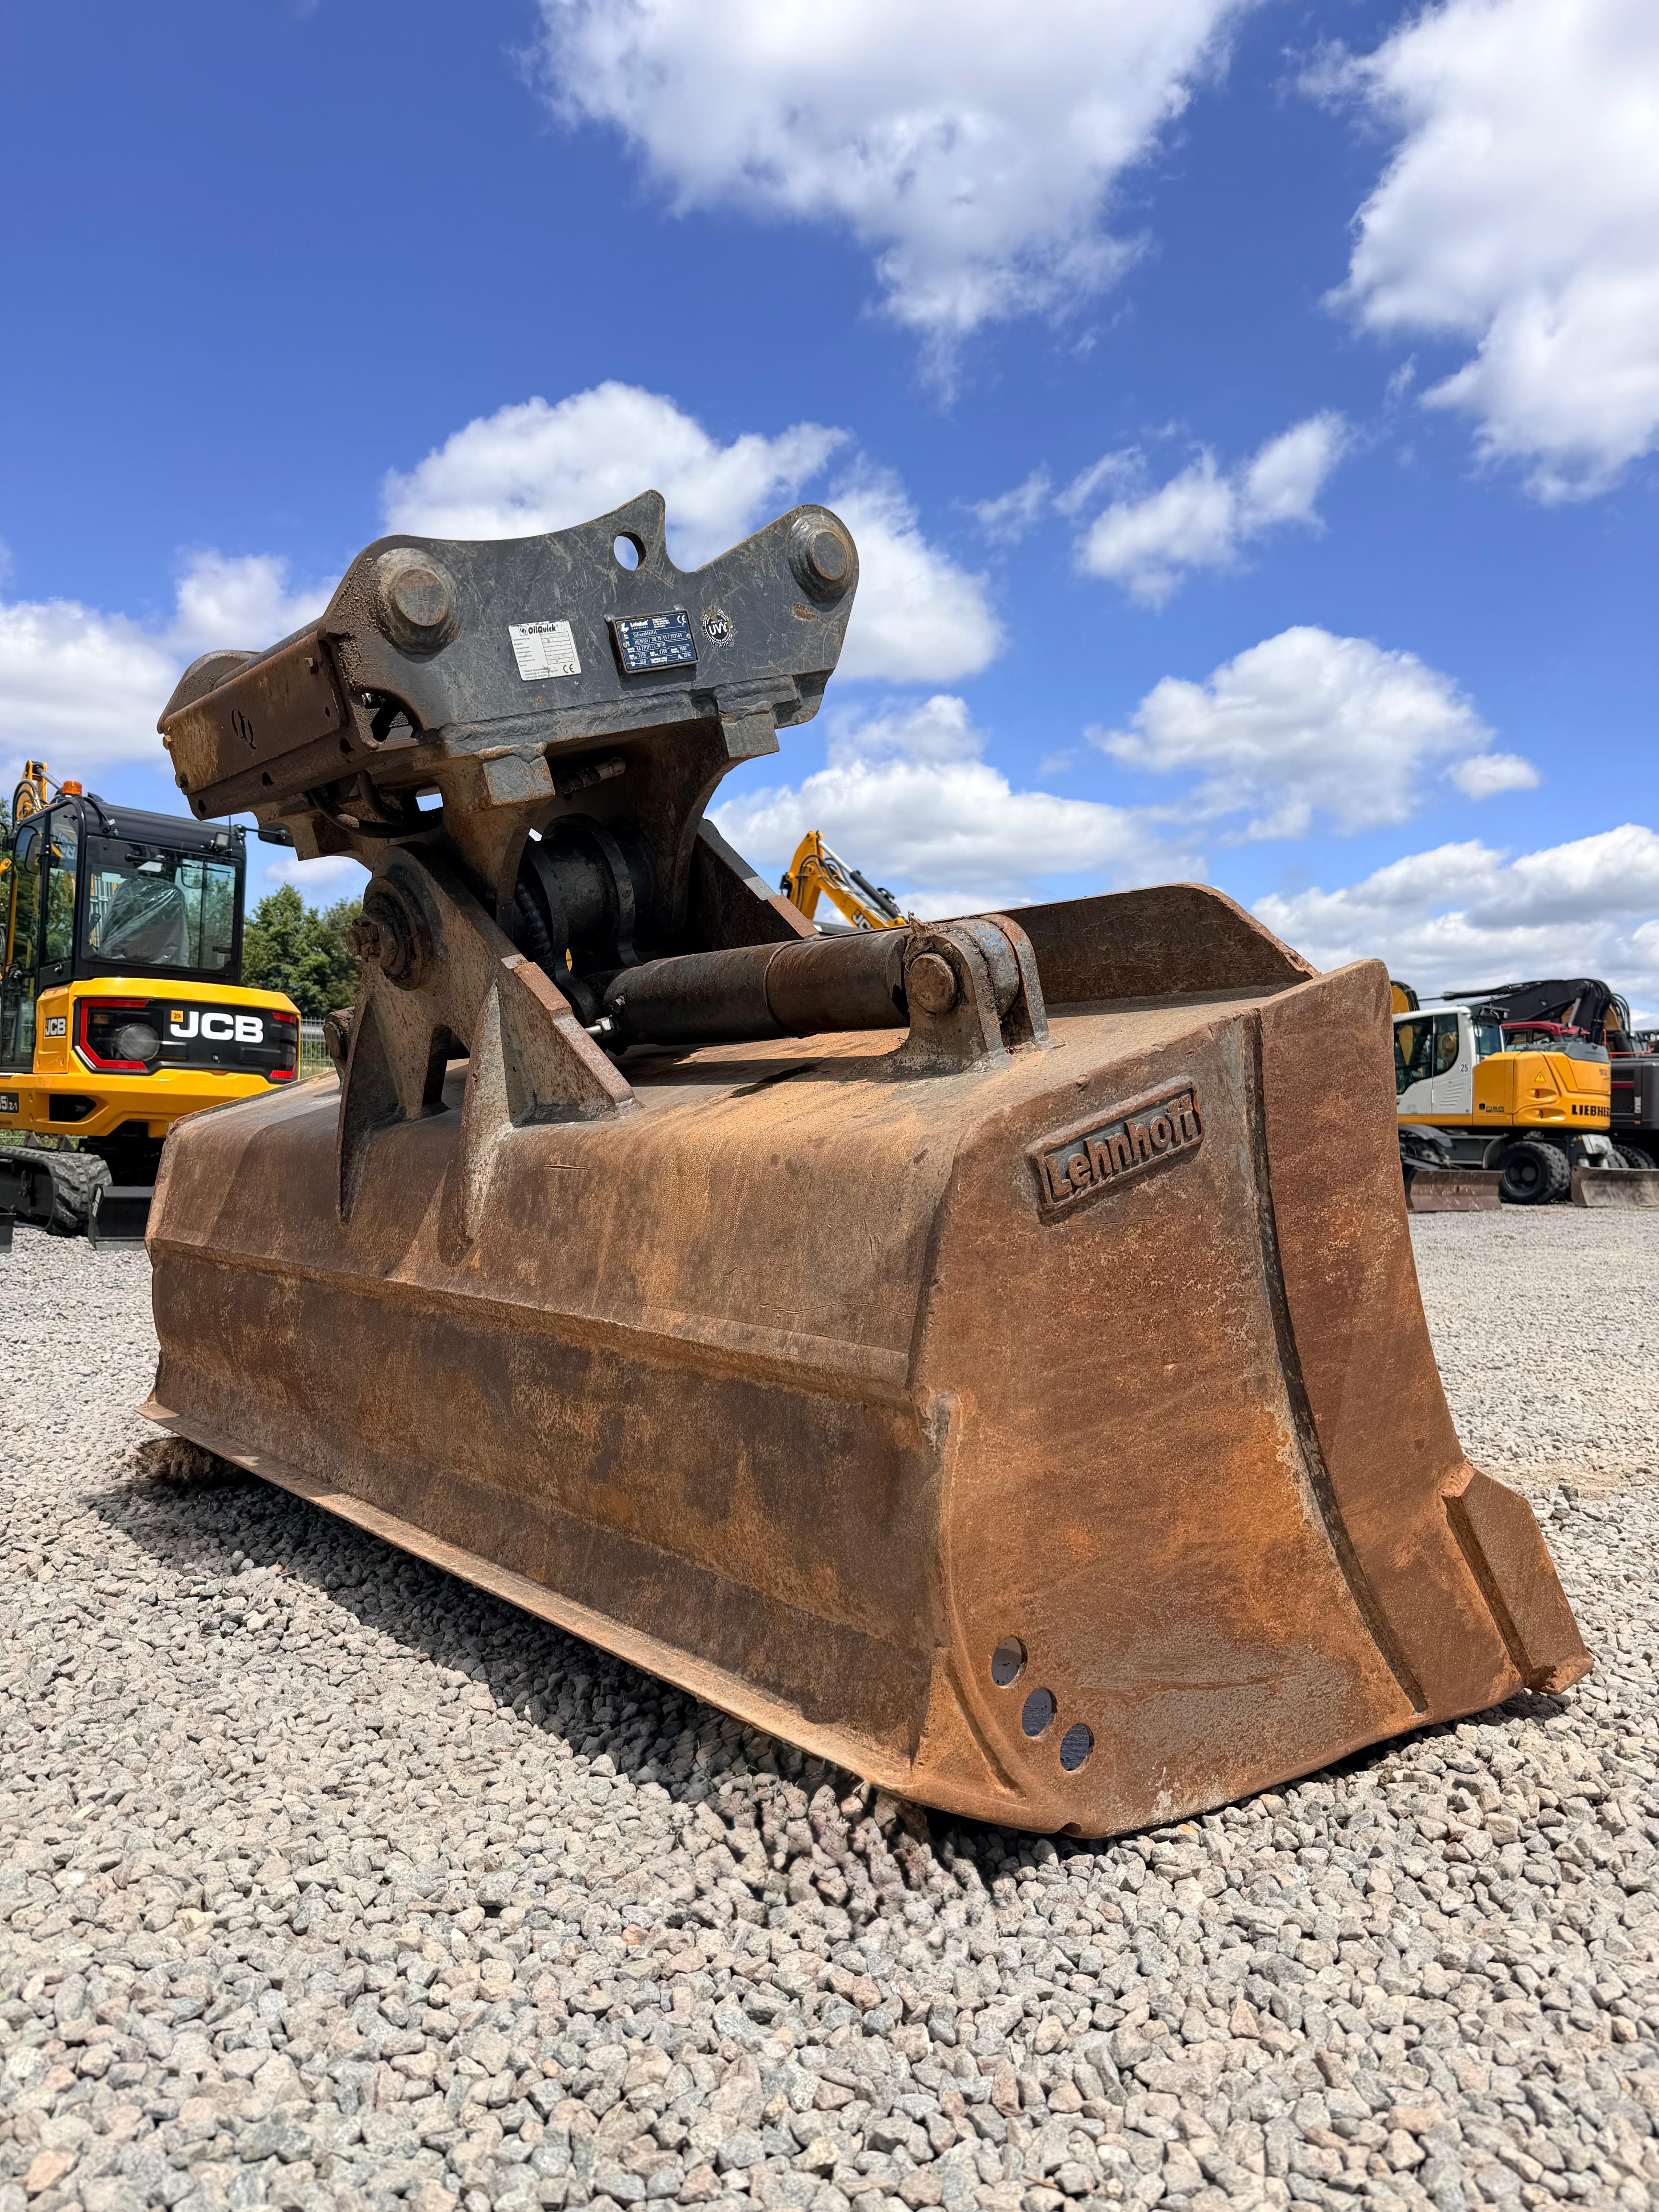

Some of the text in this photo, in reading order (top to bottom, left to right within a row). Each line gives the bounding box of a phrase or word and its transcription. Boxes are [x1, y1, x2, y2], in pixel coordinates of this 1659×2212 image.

[528, 624, 556, 634] OilQuick
[852, 913, 871, 930] JC
[45, 1018, 66, 1036] JCB
[170, 1011, 264, 1043] JCB
[1044, 1093, 1198, 1197] Lehnhoff
